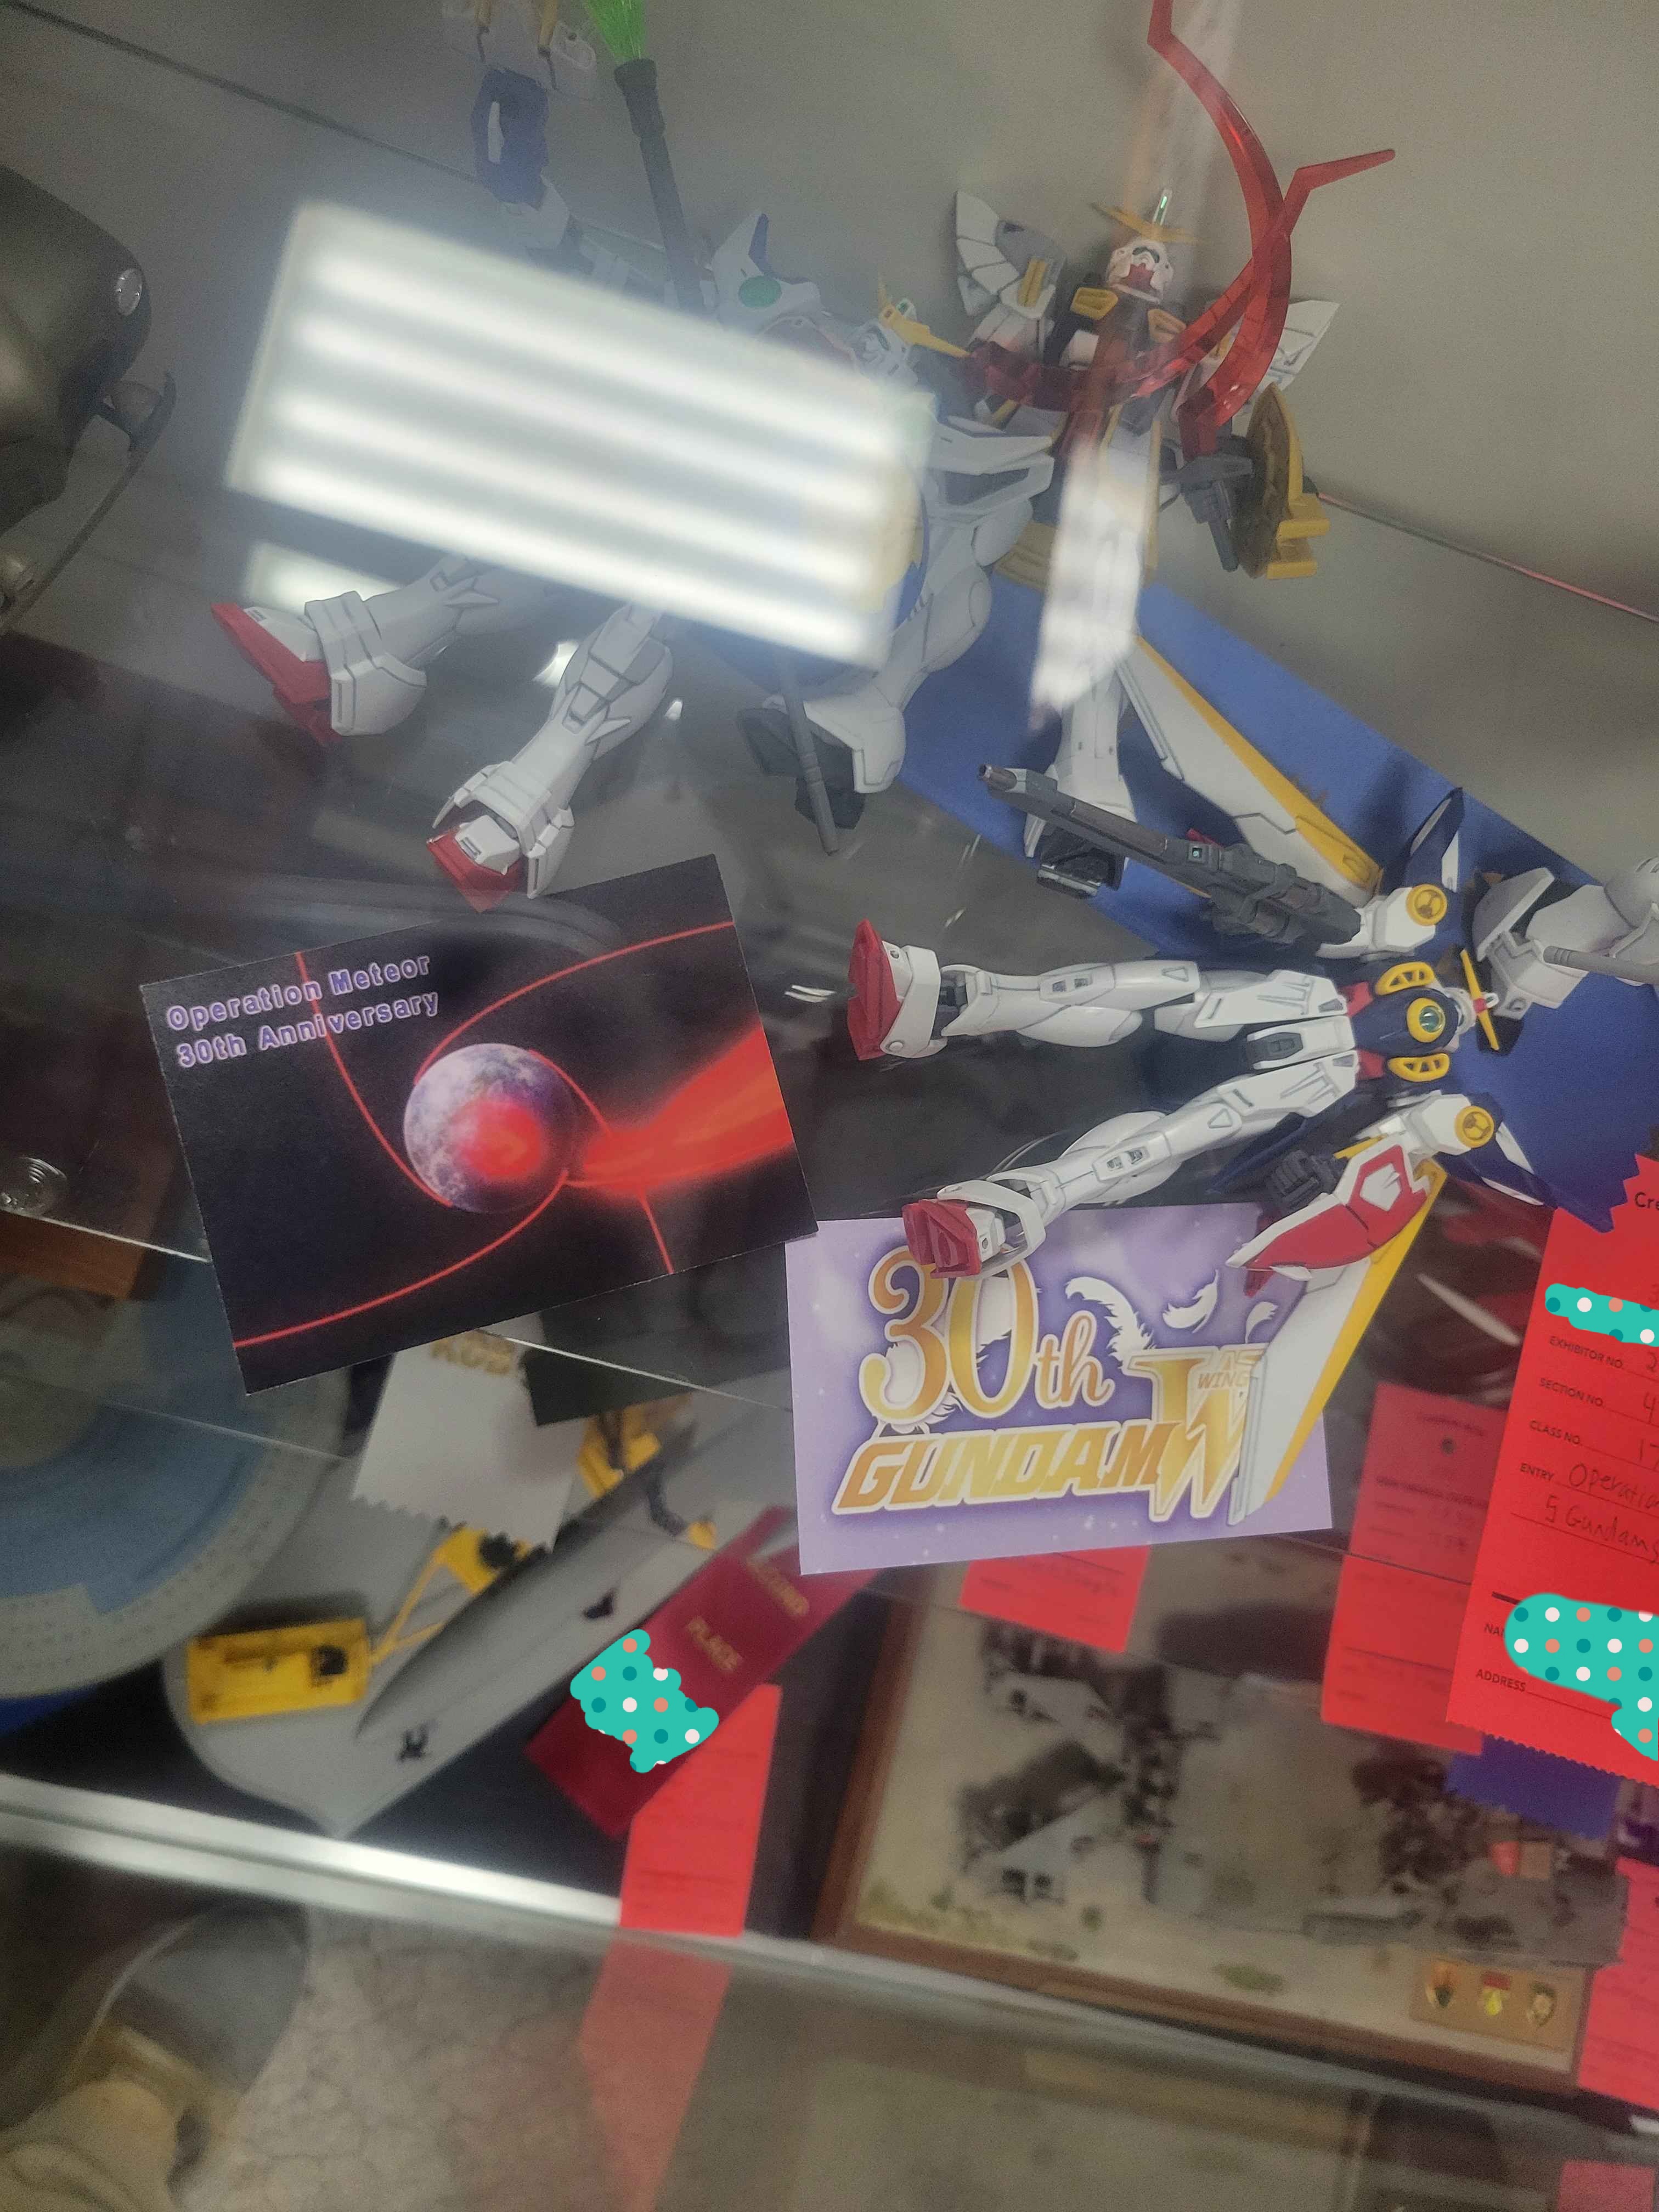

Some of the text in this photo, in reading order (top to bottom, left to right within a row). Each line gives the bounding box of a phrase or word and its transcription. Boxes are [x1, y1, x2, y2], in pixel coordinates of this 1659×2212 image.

[166, 956, 430, 1031] Operation Meteor
[176, 991, 439, 1068] 30th Anniversary
[859, 1245, 1116, 1419] 30th
[1549, 1336, 1605, 1362] EXHIBITOR
[1540, 1378, 1585, 1401] SECTION
[1530, 1420, 1562, 1440] CLASS
[834, 1418, 1181, 1513] GUNDAM
[1520, 1463, 1554, 1481] ENTRY
[1476, 1668, 1526, 1692] ADDRESS
